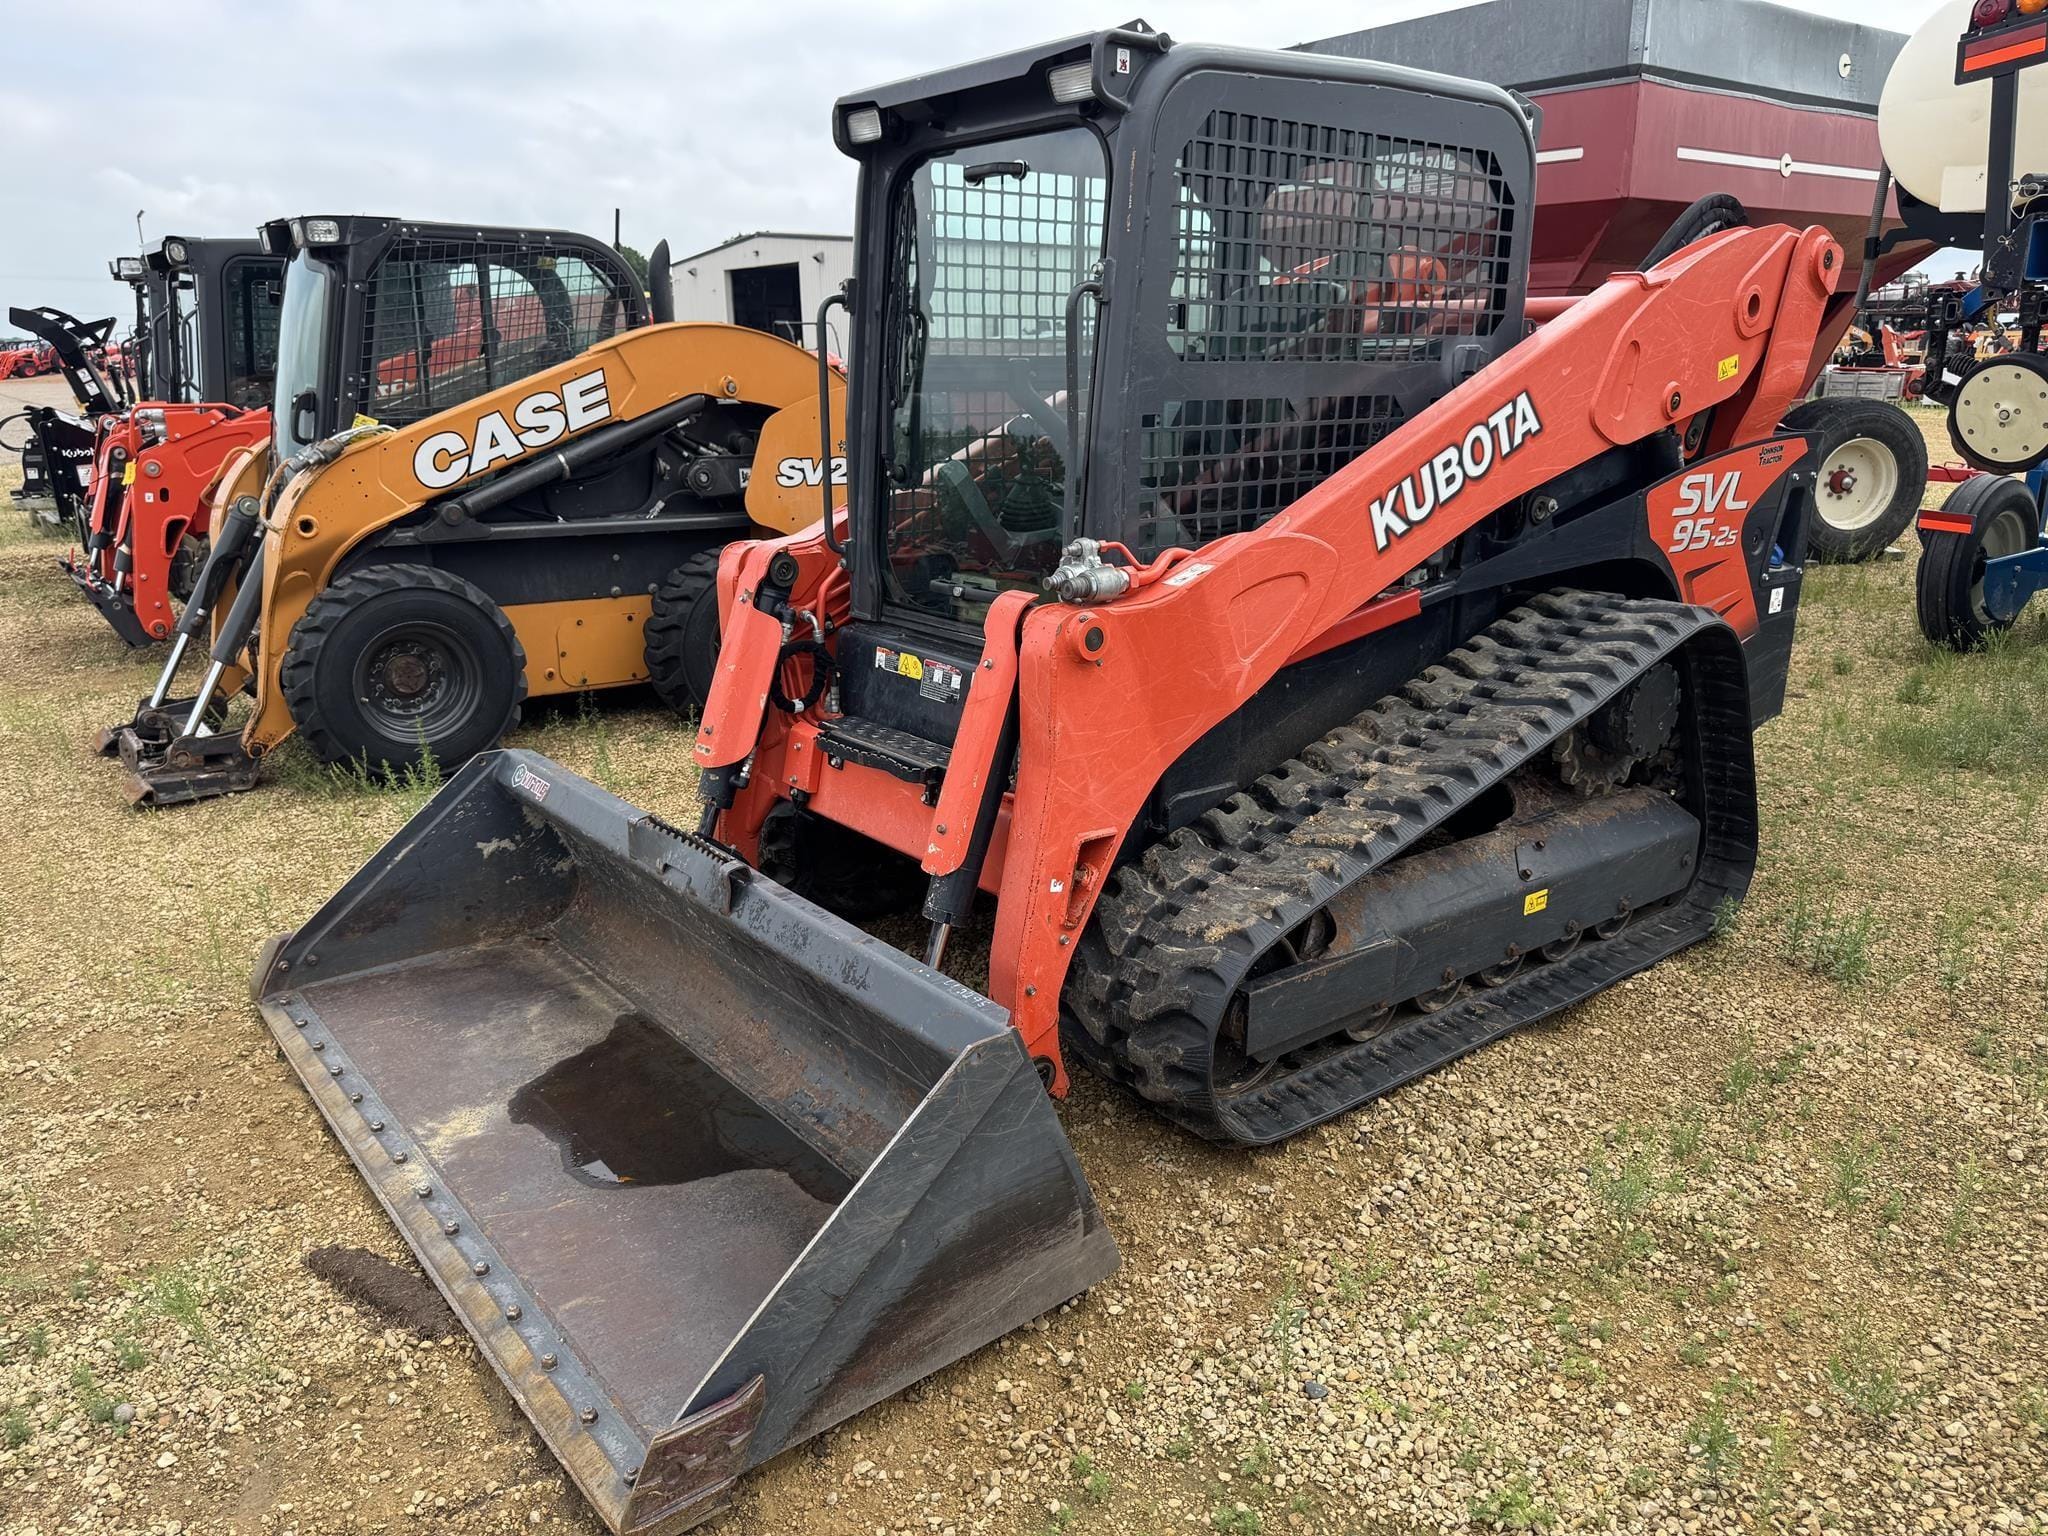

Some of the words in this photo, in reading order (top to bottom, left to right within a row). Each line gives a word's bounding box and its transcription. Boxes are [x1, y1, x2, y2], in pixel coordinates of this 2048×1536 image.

[413, 367, 612, 489] CASE
[61, 447, 95, 458] Kubot
[776, 456, 848, 488] SV2
[1369, 390, 1543, 552] KUBOTA
[1671, 471, 1749, 517] SVL
